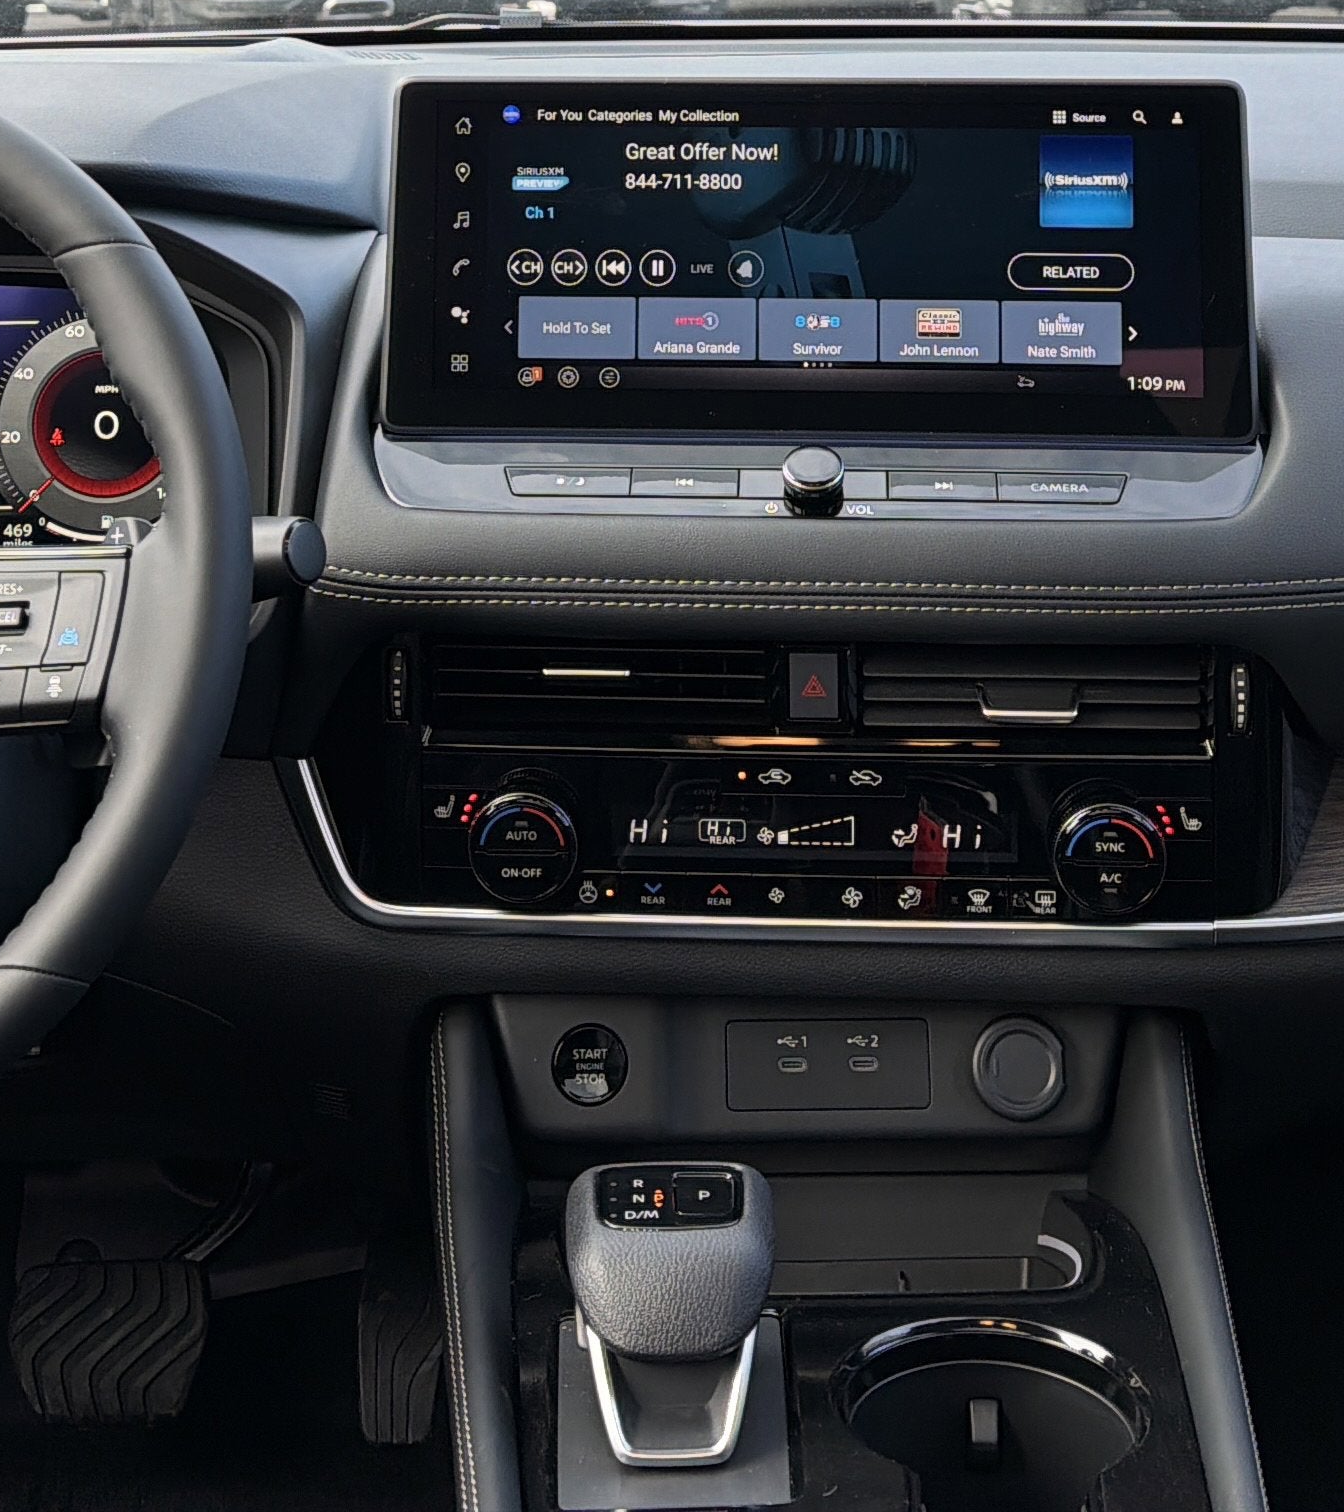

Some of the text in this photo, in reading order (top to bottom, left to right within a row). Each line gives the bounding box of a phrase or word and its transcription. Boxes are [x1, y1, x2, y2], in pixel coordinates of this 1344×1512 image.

[537, 109, 739, 123] For You Categories My Collection
[1072, 112, 1106, 123] Source
[625, 143, 779, 161] Great Offer Now!
[516, 166, 564, 176] SIRIUSXM
[625, 173, 742, 190] 844-711-8800
[525, 207, 555, 219] Ch 1
[690, 263, 714, 274] LIVE
[1042, 266, 1099, 279] RELATED
[65, 325, 85, 338] 60
[543, 322, 612, 335] Hold To Set
[1038, 317, 1084, 338] highway
[653, 341, 741, 355] Ariana Grande
[793, 343, 843, 356] Survivor
[900, 344, 979, 357] John Lennon
[1028, 345, 1096, 358] Nate Smith
[13, 368, 34, 380] 40
[94, 385, 119, 394] MPH
[1127, 376, 1185, 391] 1:09 PM
[94, 410, 120, 440] 0
[1, 430, 21, 444] 20
[1031, 483, 1089, 493] CAMERA
[846, 504, 874, 515] VOL
[38, 516, 46, 527] 0
[3, 523, 33, 537] 469
[629, 819, 668, 843] Hi
[707, 822, 731, 836] Hi
[506, 831, 538, 841] AUTO
[709, 836, 736, 845] REAR
[942, 824, 982, 849] Hi
[1095, 842, 1126, 853] SYNC
[1099, 873, 1123, 884] A/C
[640, 895, 665, 905] REAR
[706, 897, 732, 907] REAR
[966, 906, 993, 914] FRONT
[1035, 906, 1056, 915] REAR
[801, 1035, 807, 1047] 1
[870, 1035, 879, 1047] 2
[572, 1049, 607, 1059] START
[575, 1074, 606, 1085] STOP
[632, 1178, 644, 1188] R
[632, 1194, 645, 1203] N
[698, 1191, 711, 1201] P
[624, 1210, 659, 1220] D/M
